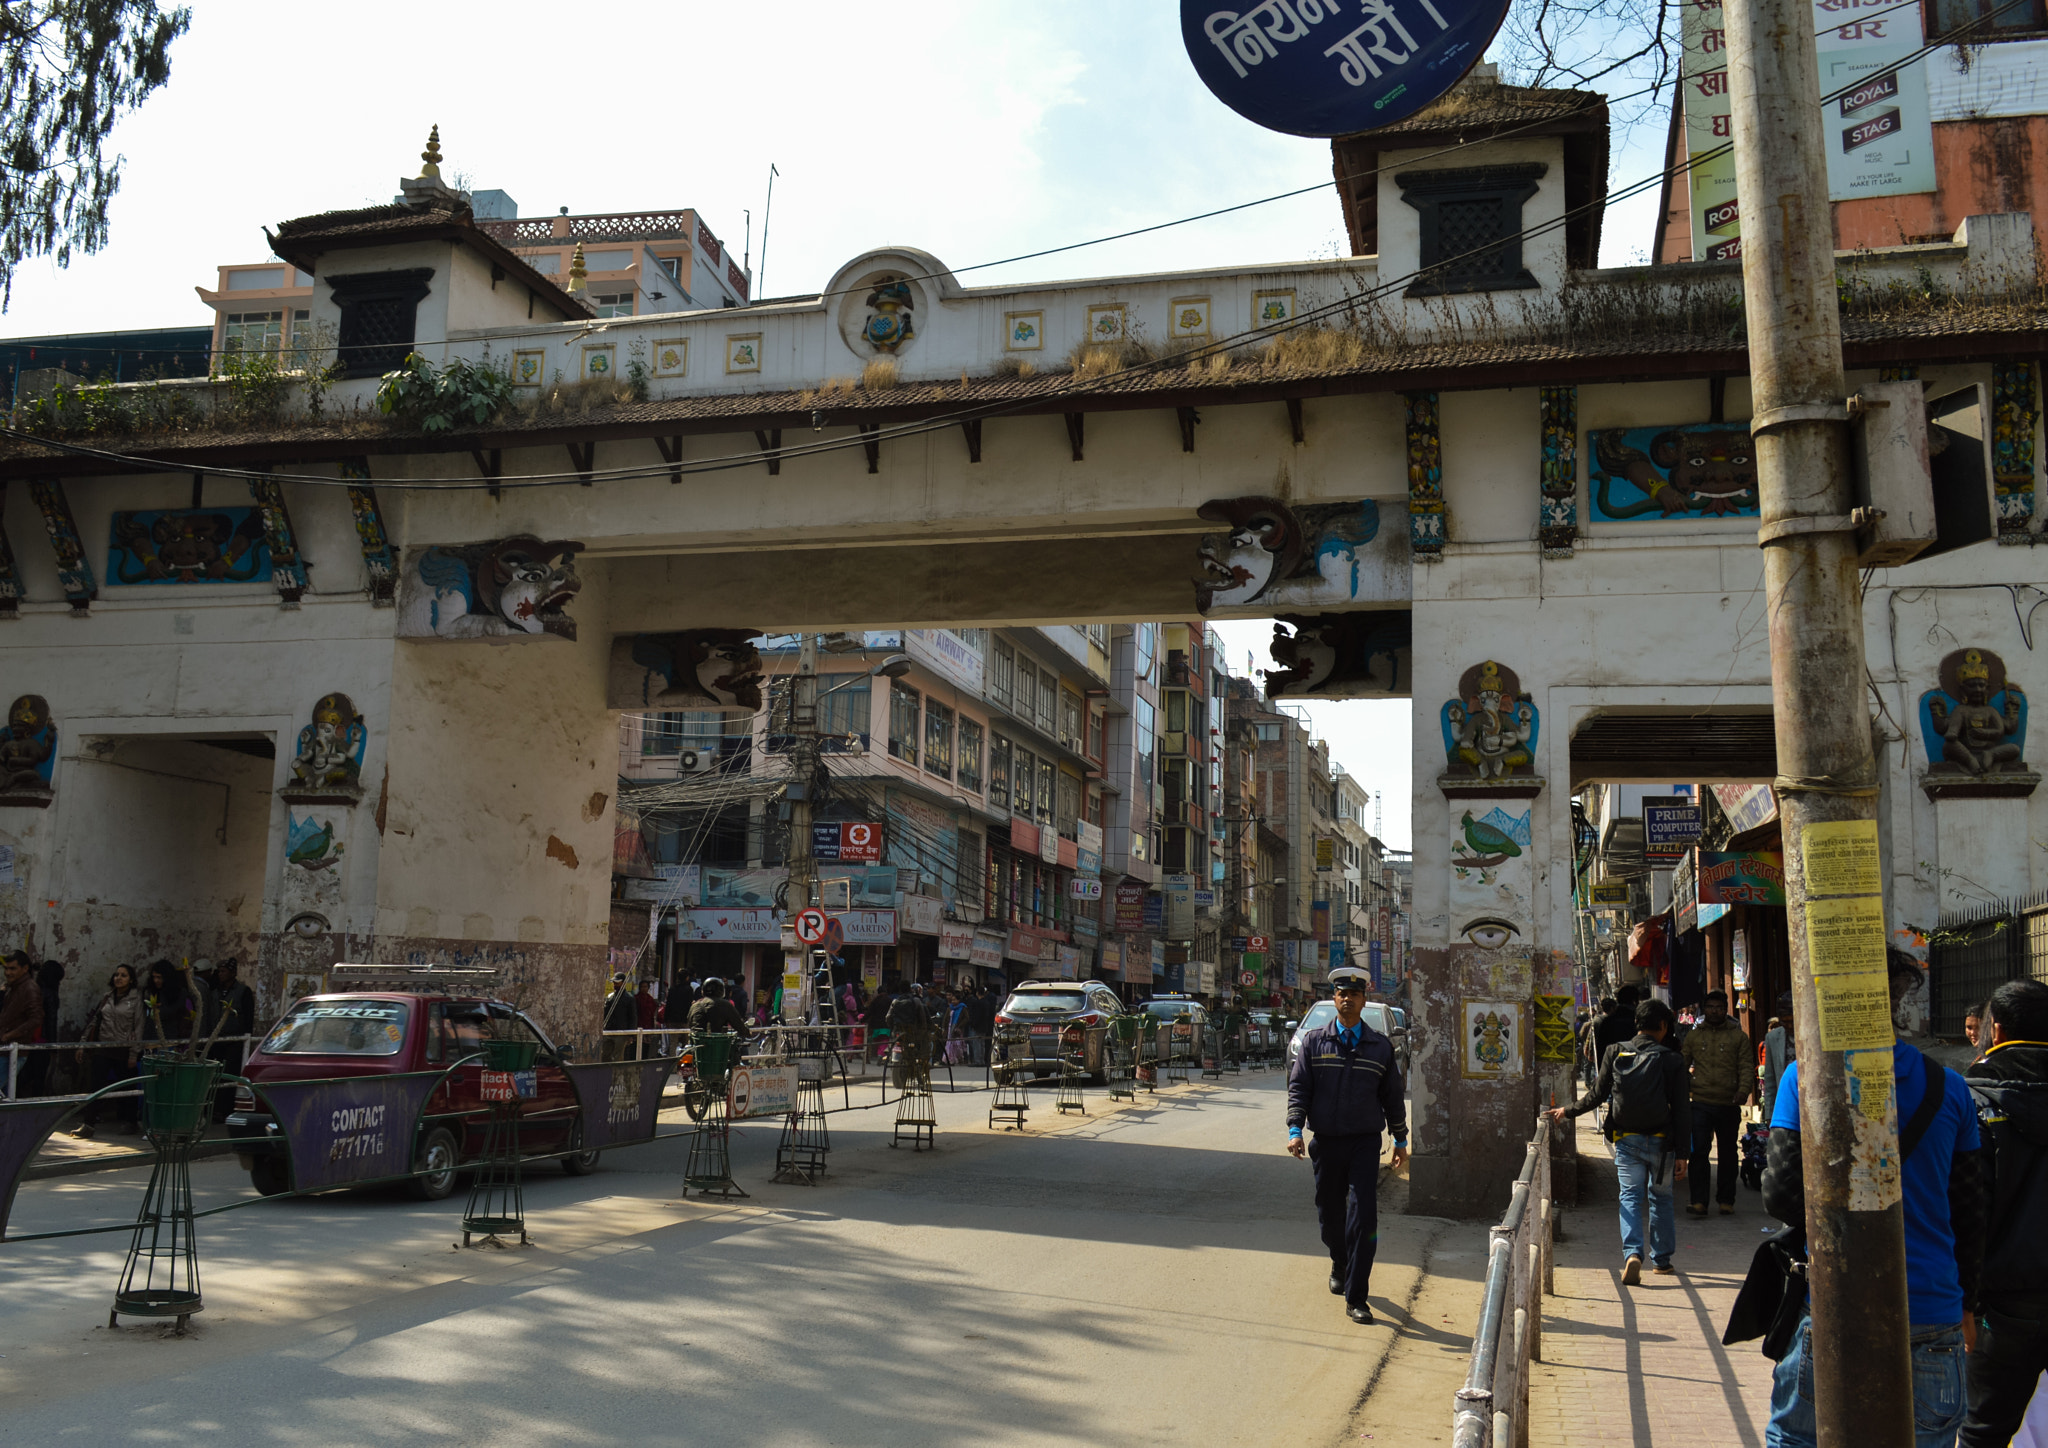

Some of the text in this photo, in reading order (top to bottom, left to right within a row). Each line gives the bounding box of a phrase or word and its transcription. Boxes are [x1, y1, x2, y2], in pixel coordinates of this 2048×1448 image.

[1838, 20, 1888, 40] घर
[1848, 63, 1886, 71] SEAGRAM'S
[1844, 82, 1893, 110] ROYAL
[1852, 118, 1891, 142] STAG
[1849, 180, 1869, 188] MAKE
[1879, 177, 1902, 185] LARGE
[1708, 205, 1740, 226] ROY
[1716, 241, 1742, 261] STA
[936, 633, 966, 664] AIRWAY
[1655, 810, 1696, 821] PRIME
[1650, 822, 1702, 833] COMPUTER
[1702, 860, 1738, 887] नेपाल
[1071, 882, 1099, 894] iLife
[1195, 892, 1213, 900] PSON
[1719, 882, 1769, 902] स्टोर
[732, 922, 767, 932] MARTIN
[851, 923, 887, 934] MARTIN
[297, 1007, 399, 1018] SPORTS
[332, 1105, 385, 1133] CONTACT
[329, 1133, 384, 1160] 4771718
